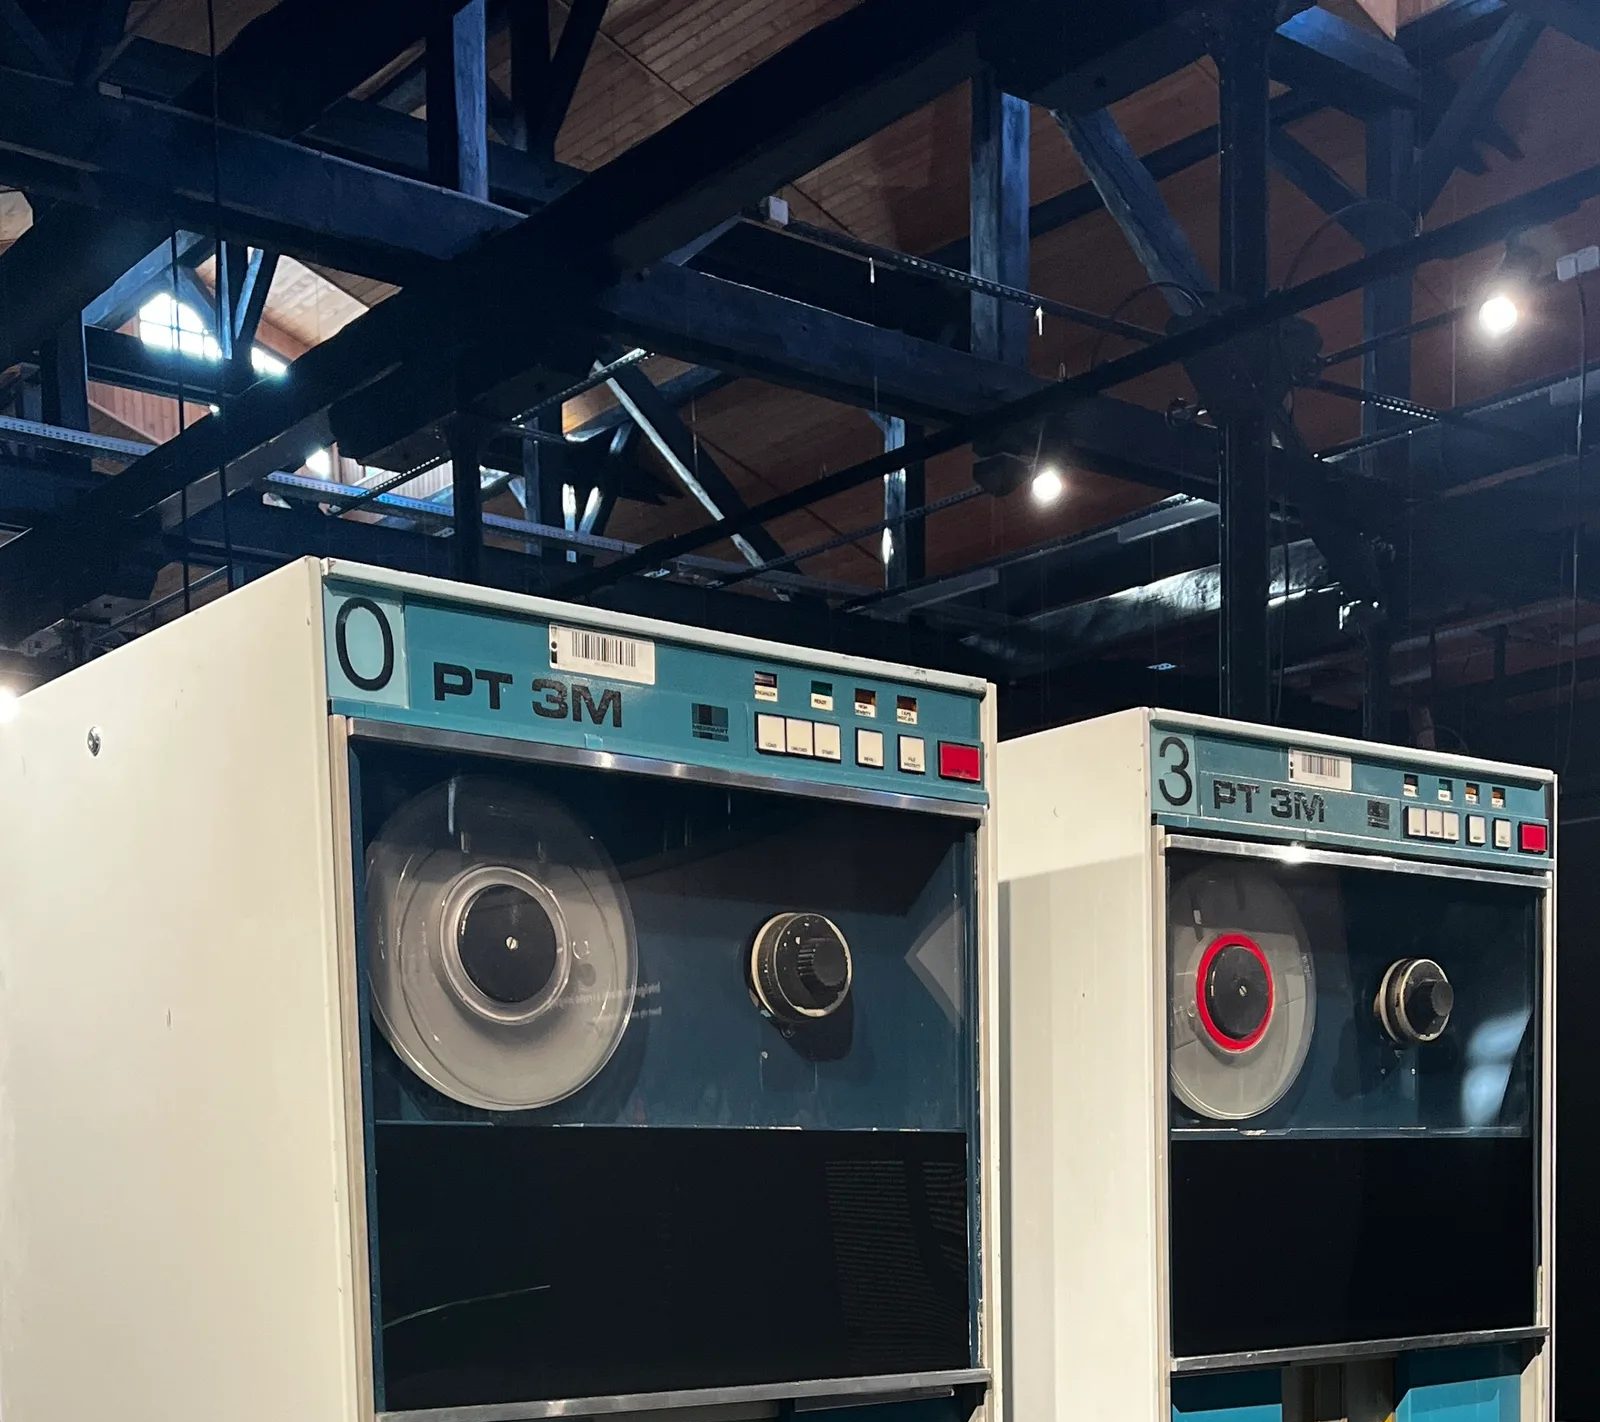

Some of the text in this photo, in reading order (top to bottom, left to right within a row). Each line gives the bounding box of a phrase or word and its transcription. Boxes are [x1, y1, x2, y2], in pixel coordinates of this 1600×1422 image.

[433, 661, 623, 729] PT 3M
[1158, 736, 1193, 806] 3
[1213, 779, 1325, 823] PT 3M
